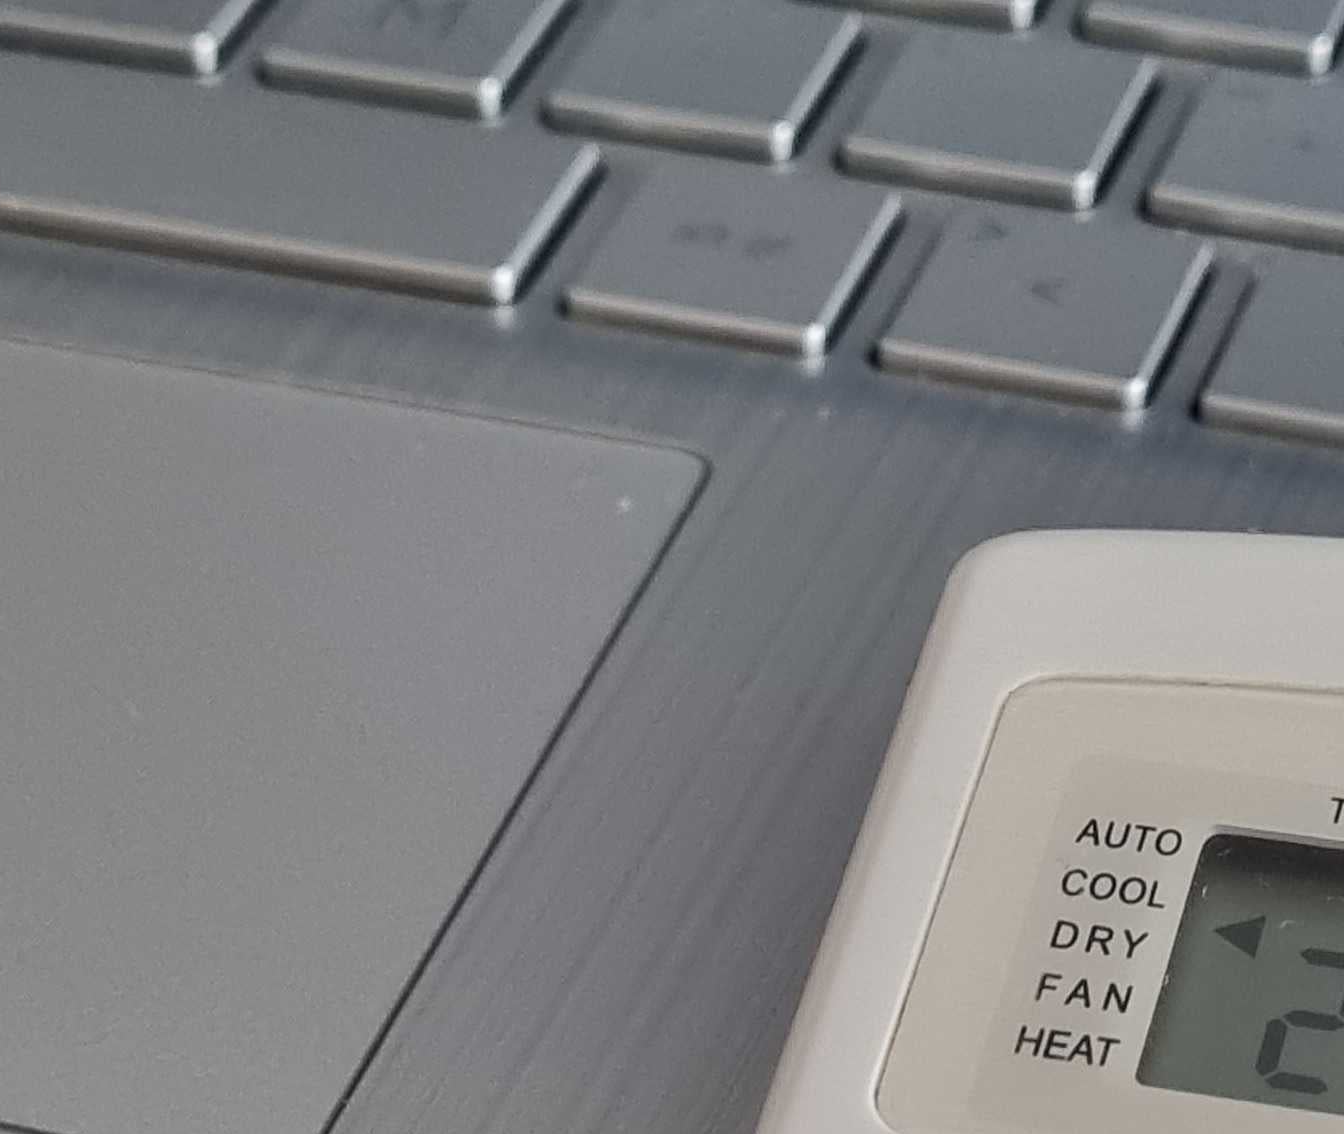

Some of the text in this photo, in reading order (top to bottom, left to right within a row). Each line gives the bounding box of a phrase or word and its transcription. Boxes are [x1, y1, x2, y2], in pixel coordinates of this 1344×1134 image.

[1076, 819, 1182, 856] AUTO
[1062, 869, 1164, 908] COOL
[1050, 920, 1148, 958] DRY
[1036, 973, 1132, 1013] FAN
[1015, 1026, 1120, 1066] HEAT
